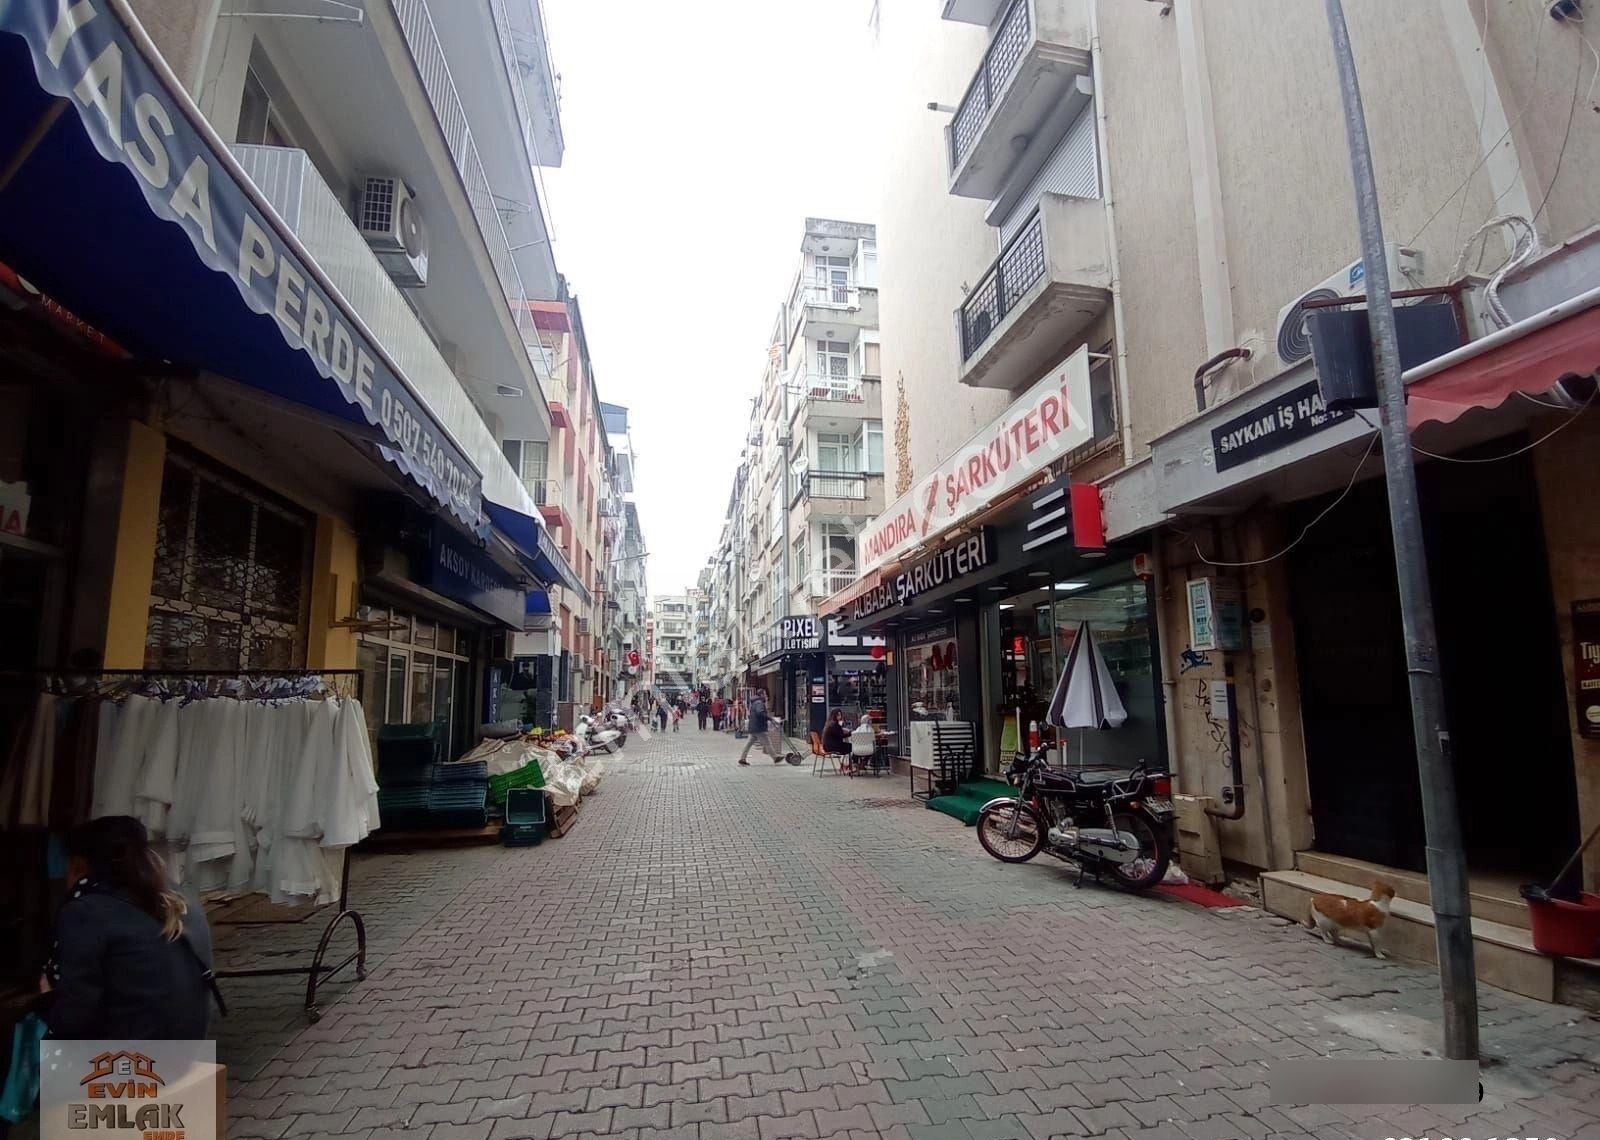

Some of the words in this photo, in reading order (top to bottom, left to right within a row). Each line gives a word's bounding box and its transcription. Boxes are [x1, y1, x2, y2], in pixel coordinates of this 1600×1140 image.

[46, 0, 219, 256] YASA
[238, 212, 376, 413] PERDE
[1219, 413, 1276, 454] SAYKAM
[1277, 406, 1294, 431] İŞ
[1296, 393, 1327, 420] HA
[863, 506, 916, 566] MANDIRA
[945, 373, 1072, 517] ŞARKÜTERİ
[439, 543, 471, 580] AKSOY
[896, 524, 988, 607] ŞARKÜTERİ
[783, 617, 819, 637] PIXEL
